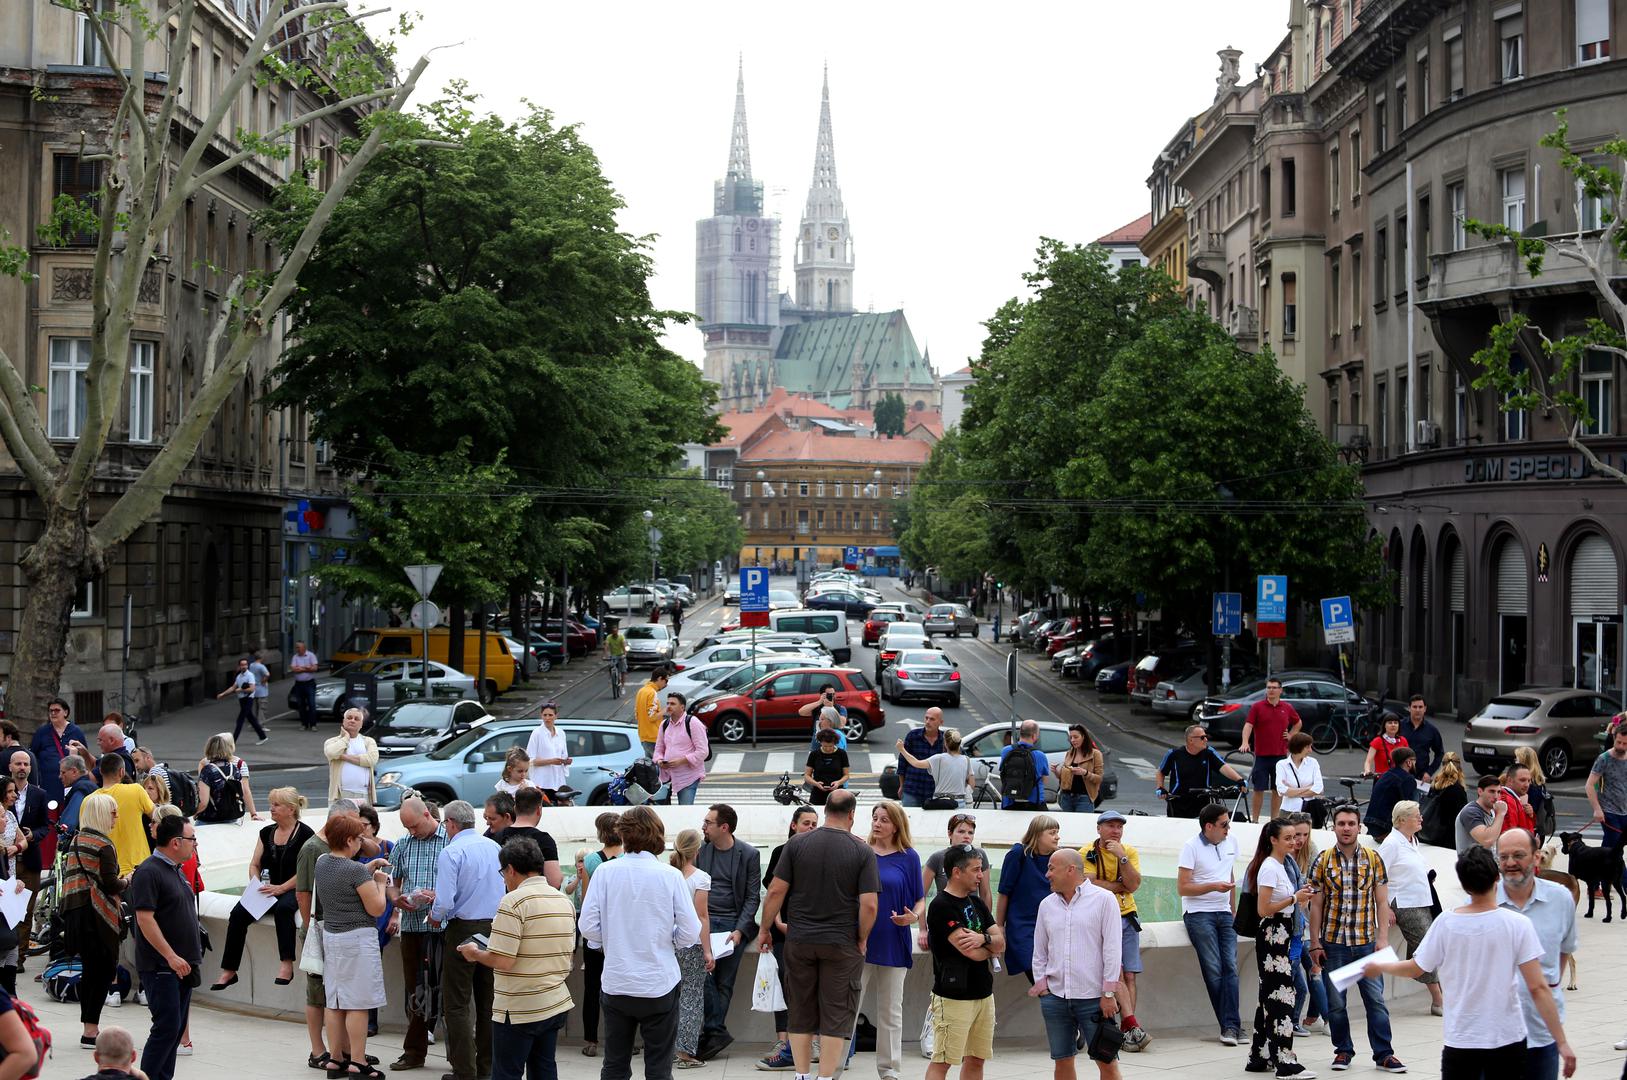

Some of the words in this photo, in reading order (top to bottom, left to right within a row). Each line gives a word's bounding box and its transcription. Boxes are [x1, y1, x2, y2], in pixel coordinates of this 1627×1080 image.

[1464, 458, 1503, 482] DOM
[747, 570, 761, 590] P
[1262, 579, 1276, 600] P
[1330, 604, 1342, 622] P
